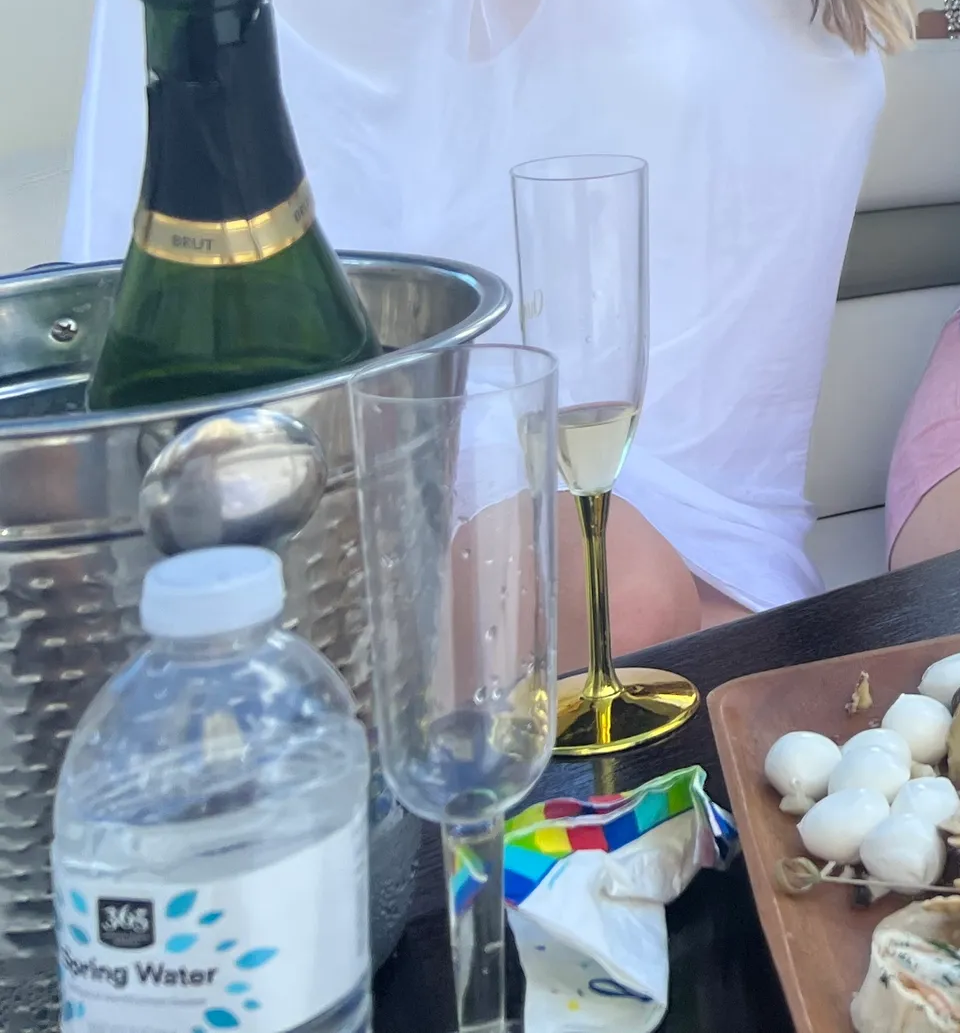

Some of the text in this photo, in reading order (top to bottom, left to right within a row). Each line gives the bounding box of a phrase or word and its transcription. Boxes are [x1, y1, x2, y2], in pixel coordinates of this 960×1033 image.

[171, 234, 214, 251] BRUT
[101, 903, 150, 934] 365
[134, 961, 217, 987] Water
